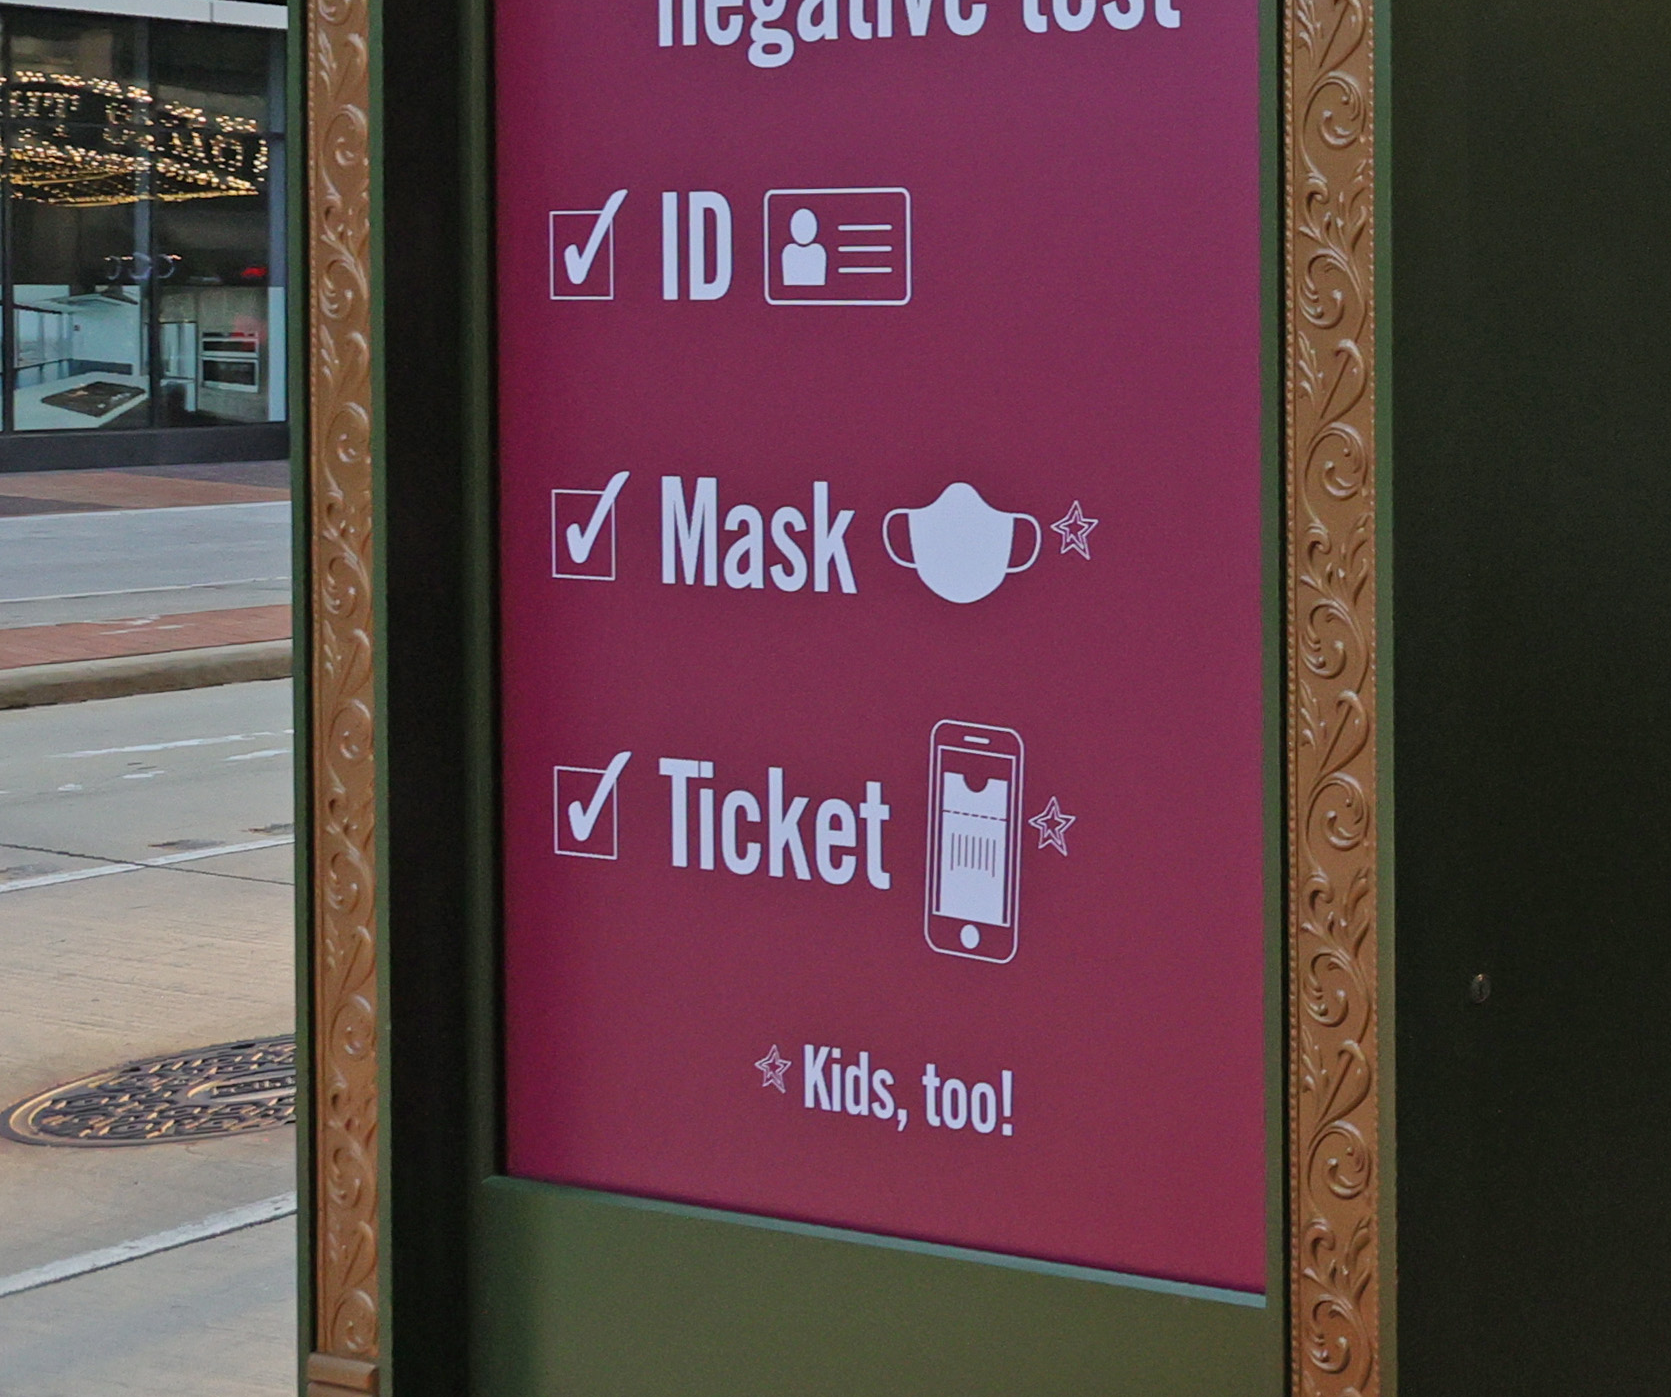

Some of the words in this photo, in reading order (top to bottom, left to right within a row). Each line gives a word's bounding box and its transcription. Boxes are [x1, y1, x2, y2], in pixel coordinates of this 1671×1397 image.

[661, 191, 733, 301] ID
[658, 475, 857, 595] Mask
[658, 757, 891, 889] Ticket
[803, 1045, 908, 1131] Kids,
[922, 1064, 1015, 1136] too!
